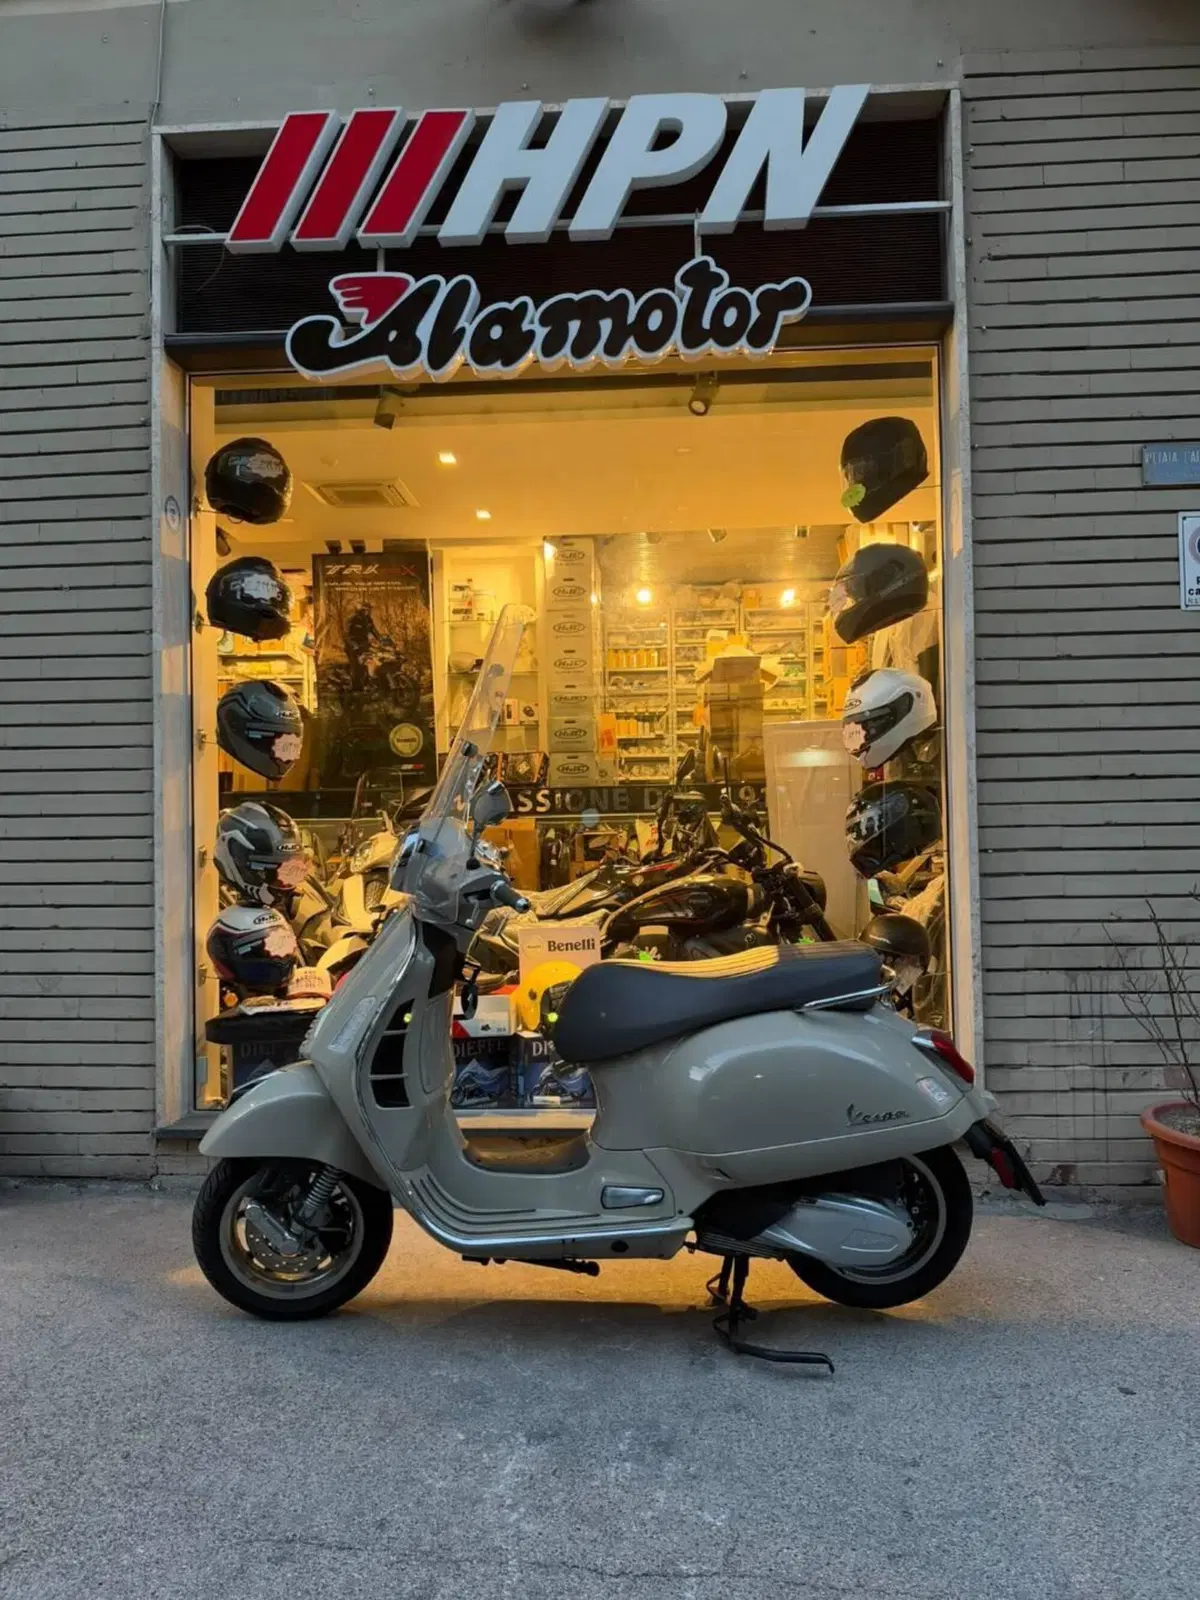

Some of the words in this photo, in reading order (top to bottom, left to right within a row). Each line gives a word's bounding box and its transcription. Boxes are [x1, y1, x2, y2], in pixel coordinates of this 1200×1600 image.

[437, 84, 870, 246] HPN
[287, 256, 811, 380] Alamotor
[323, 563, 380, 575] TRK
[508, 787, 629, 812] SSIONE
[547, 938, 595, 952] Benelli
[846, 1103, 911, 1126] Vespa
